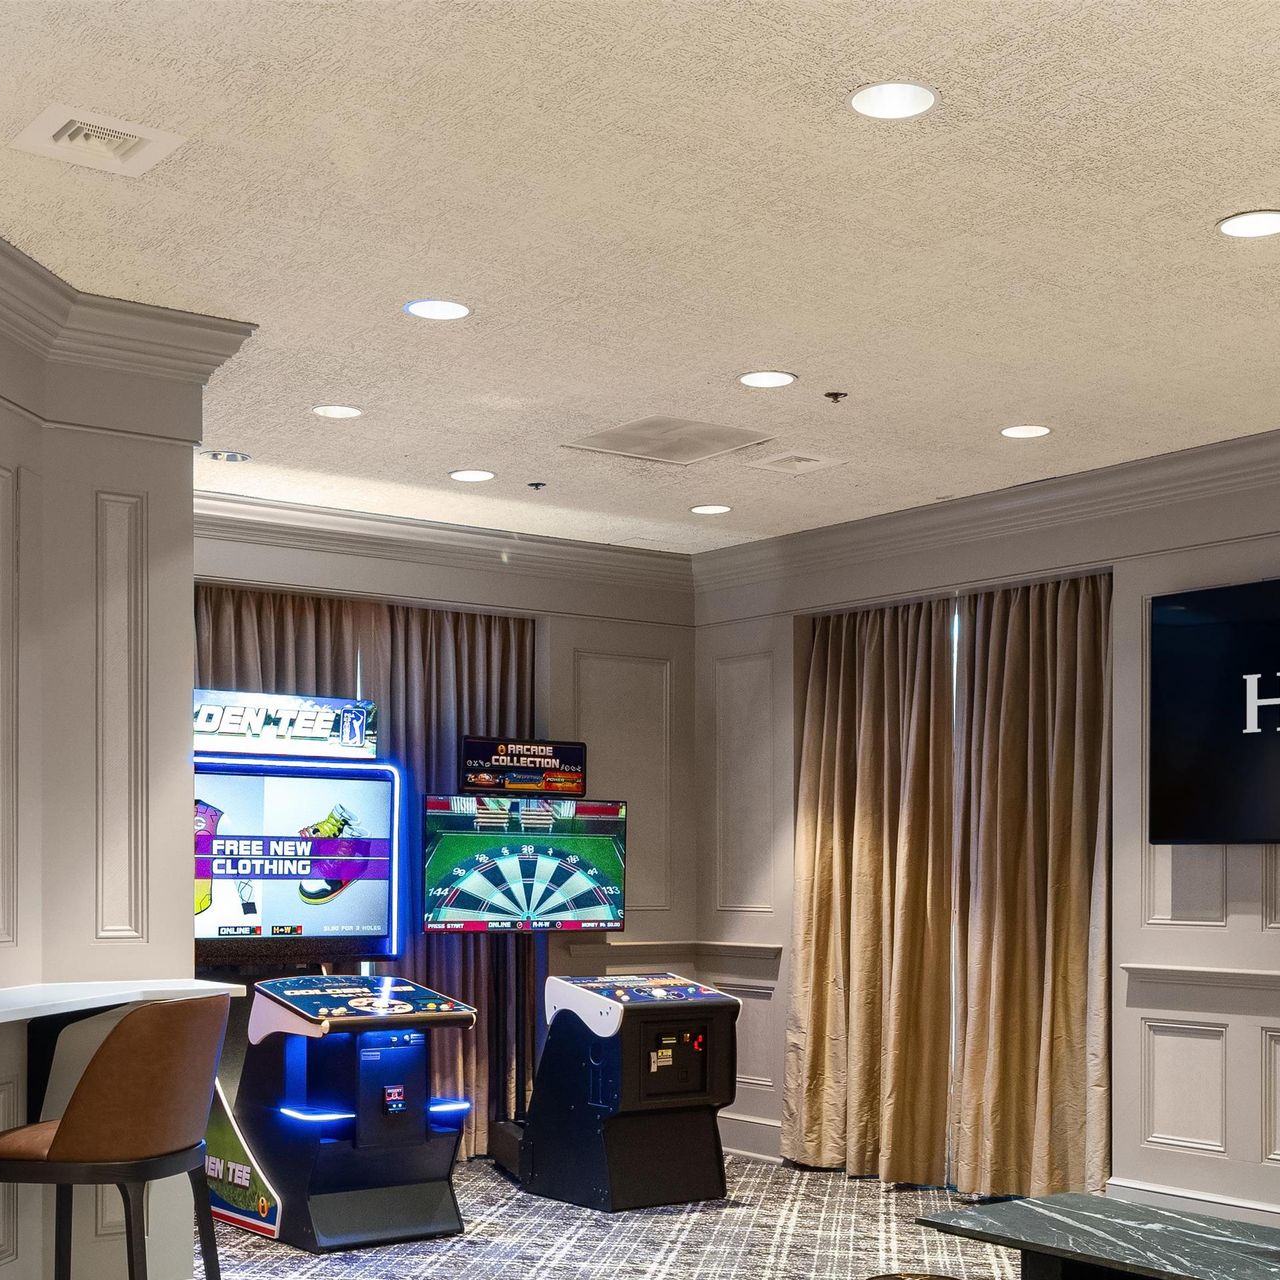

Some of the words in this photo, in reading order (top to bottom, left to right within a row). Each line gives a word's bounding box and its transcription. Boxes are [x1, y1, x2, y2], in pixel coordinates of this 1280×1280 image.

[194, 704, 266, 738] DEN
[276, 709, 336, 741] TEE
[507, 744, 554, 757] ARCADE
[491, 755, 561, 769] COLLECTION
[211, 839, 264, 856] FREE
[270, 840, 313, 857] NEW
[211, 859, 312, 876] CLOTHING
[219, 926, 251, 935] ONLINE
[227, 1161, 251, 1187] TEE
